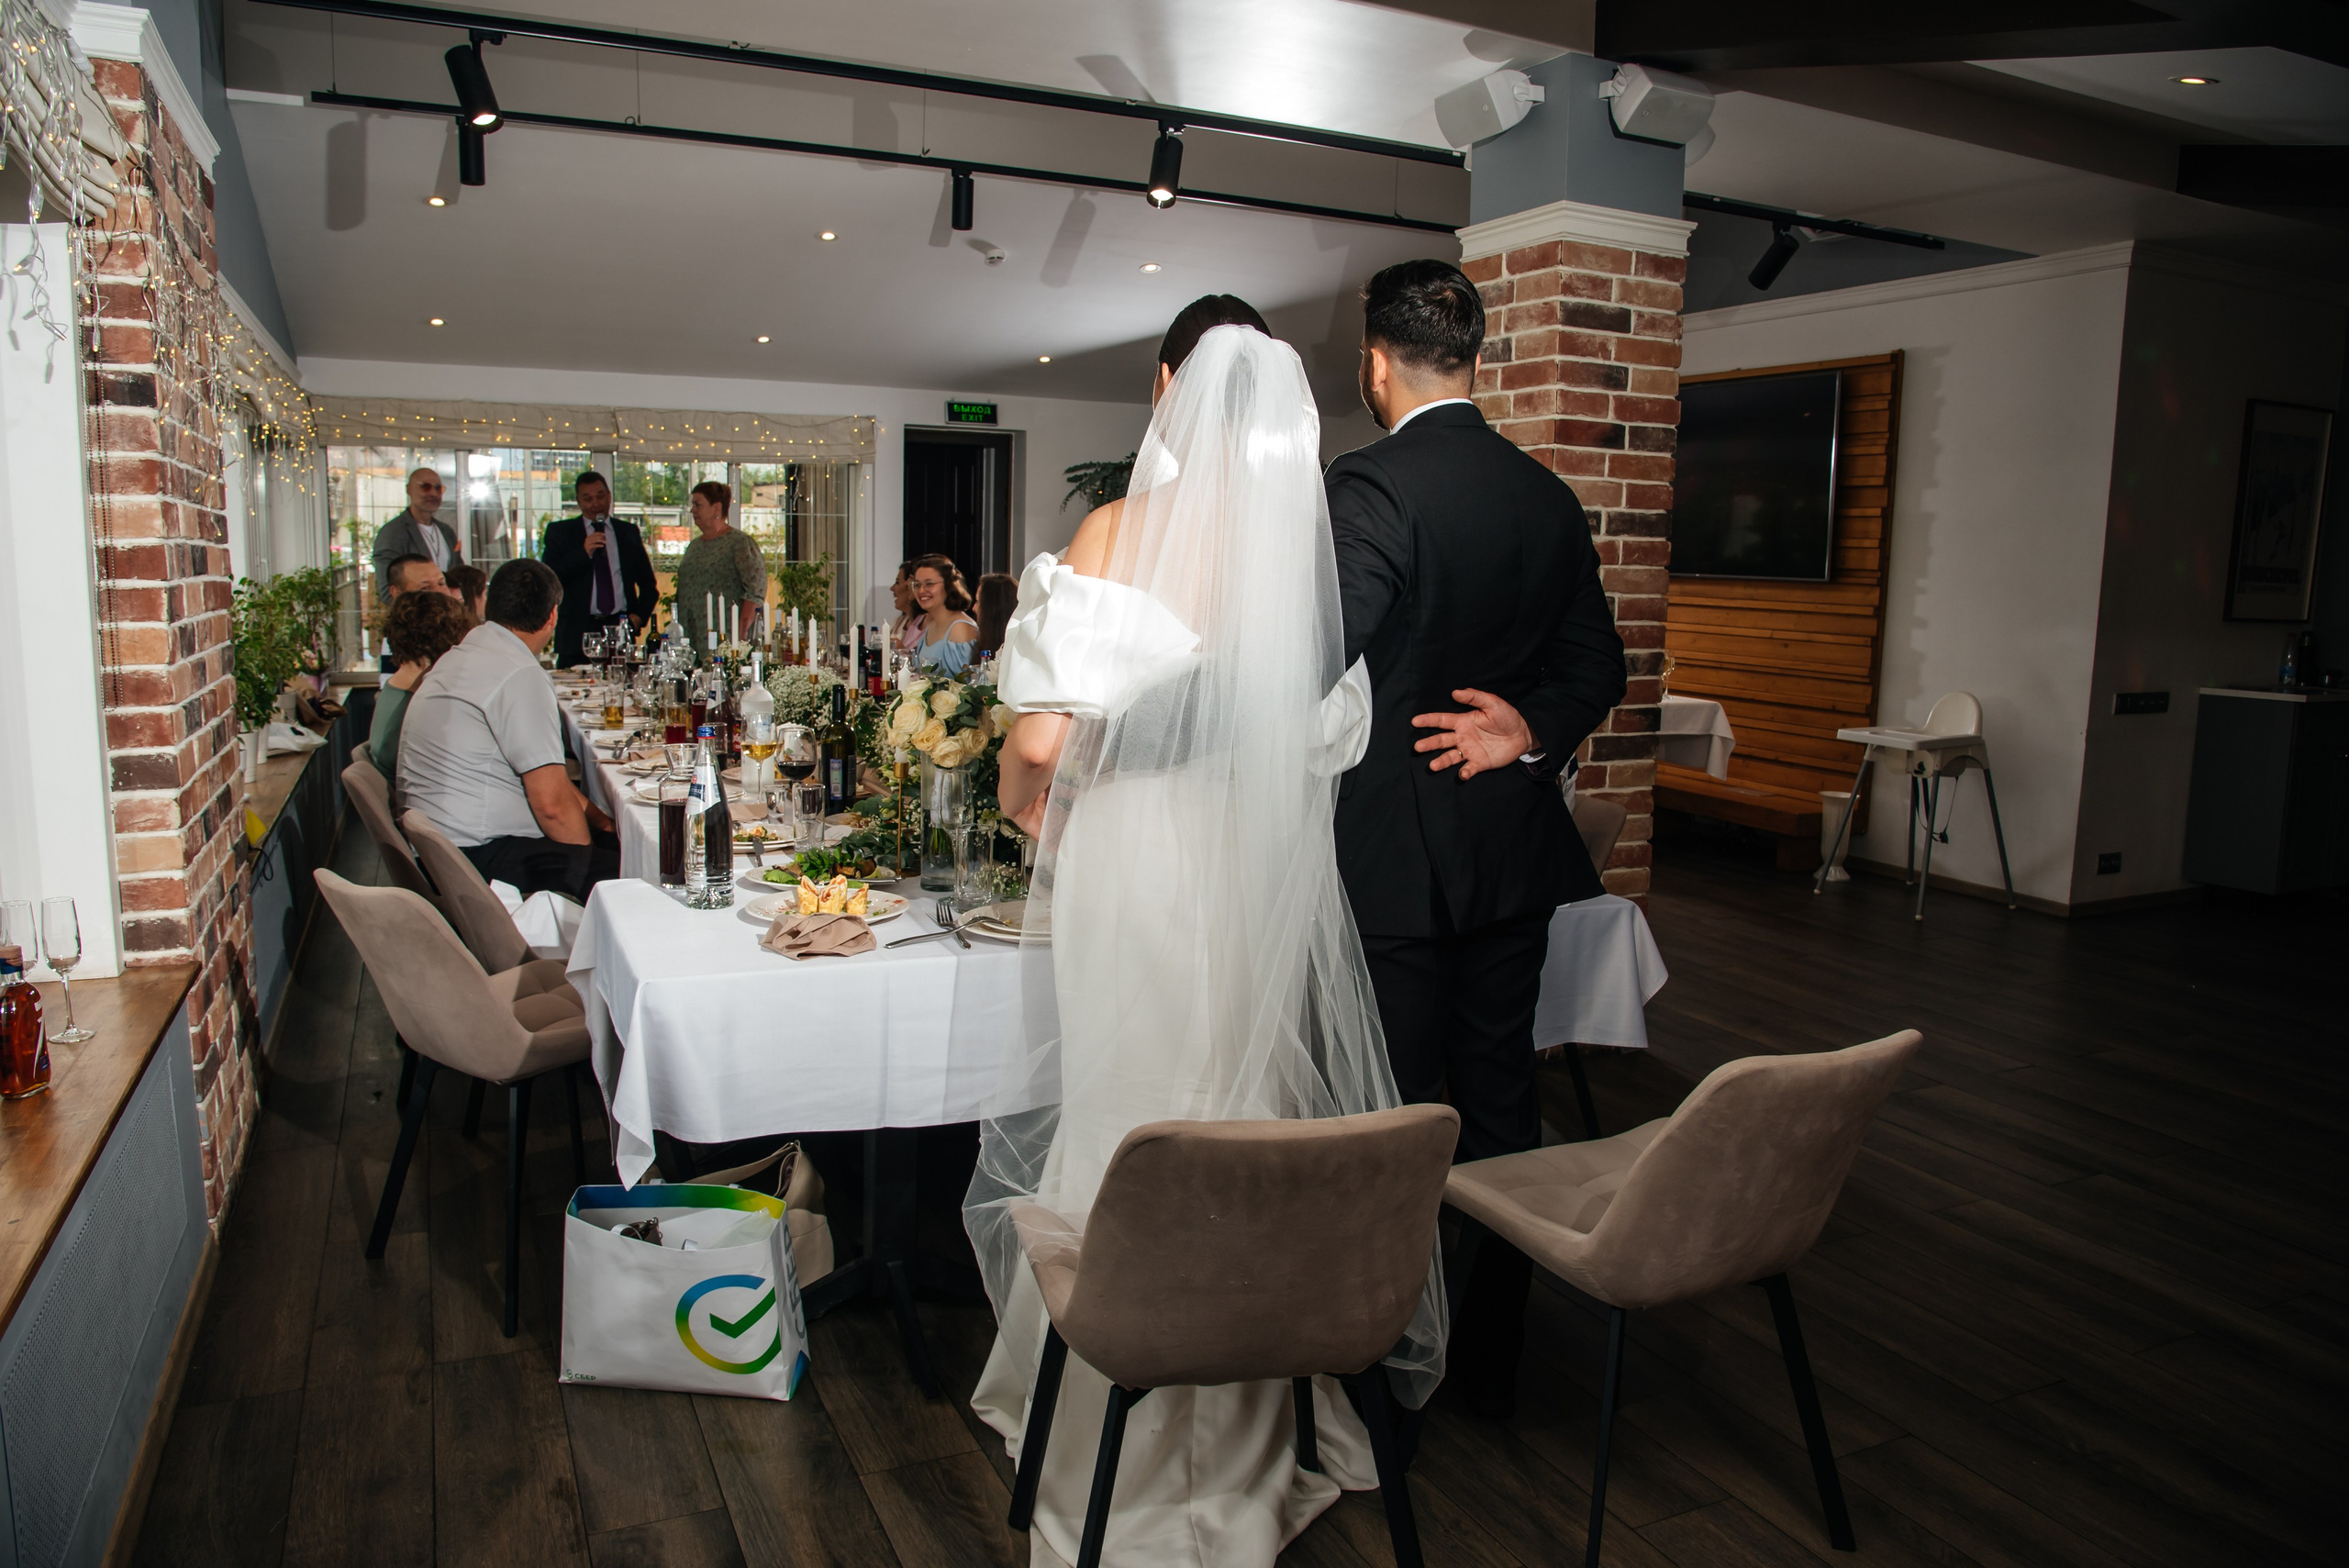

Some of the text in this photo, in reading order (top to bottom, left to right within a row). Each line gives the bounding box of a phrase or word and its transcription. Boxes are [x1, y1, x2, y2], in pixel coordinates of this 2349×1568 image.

[953, 405, 991, 414] ВЫХОД
[962, 414, 984, 422] EXIT
[784, 1224, 807, 1339] СБЕР
[574, 1373, 596, 1381] СБЕР
